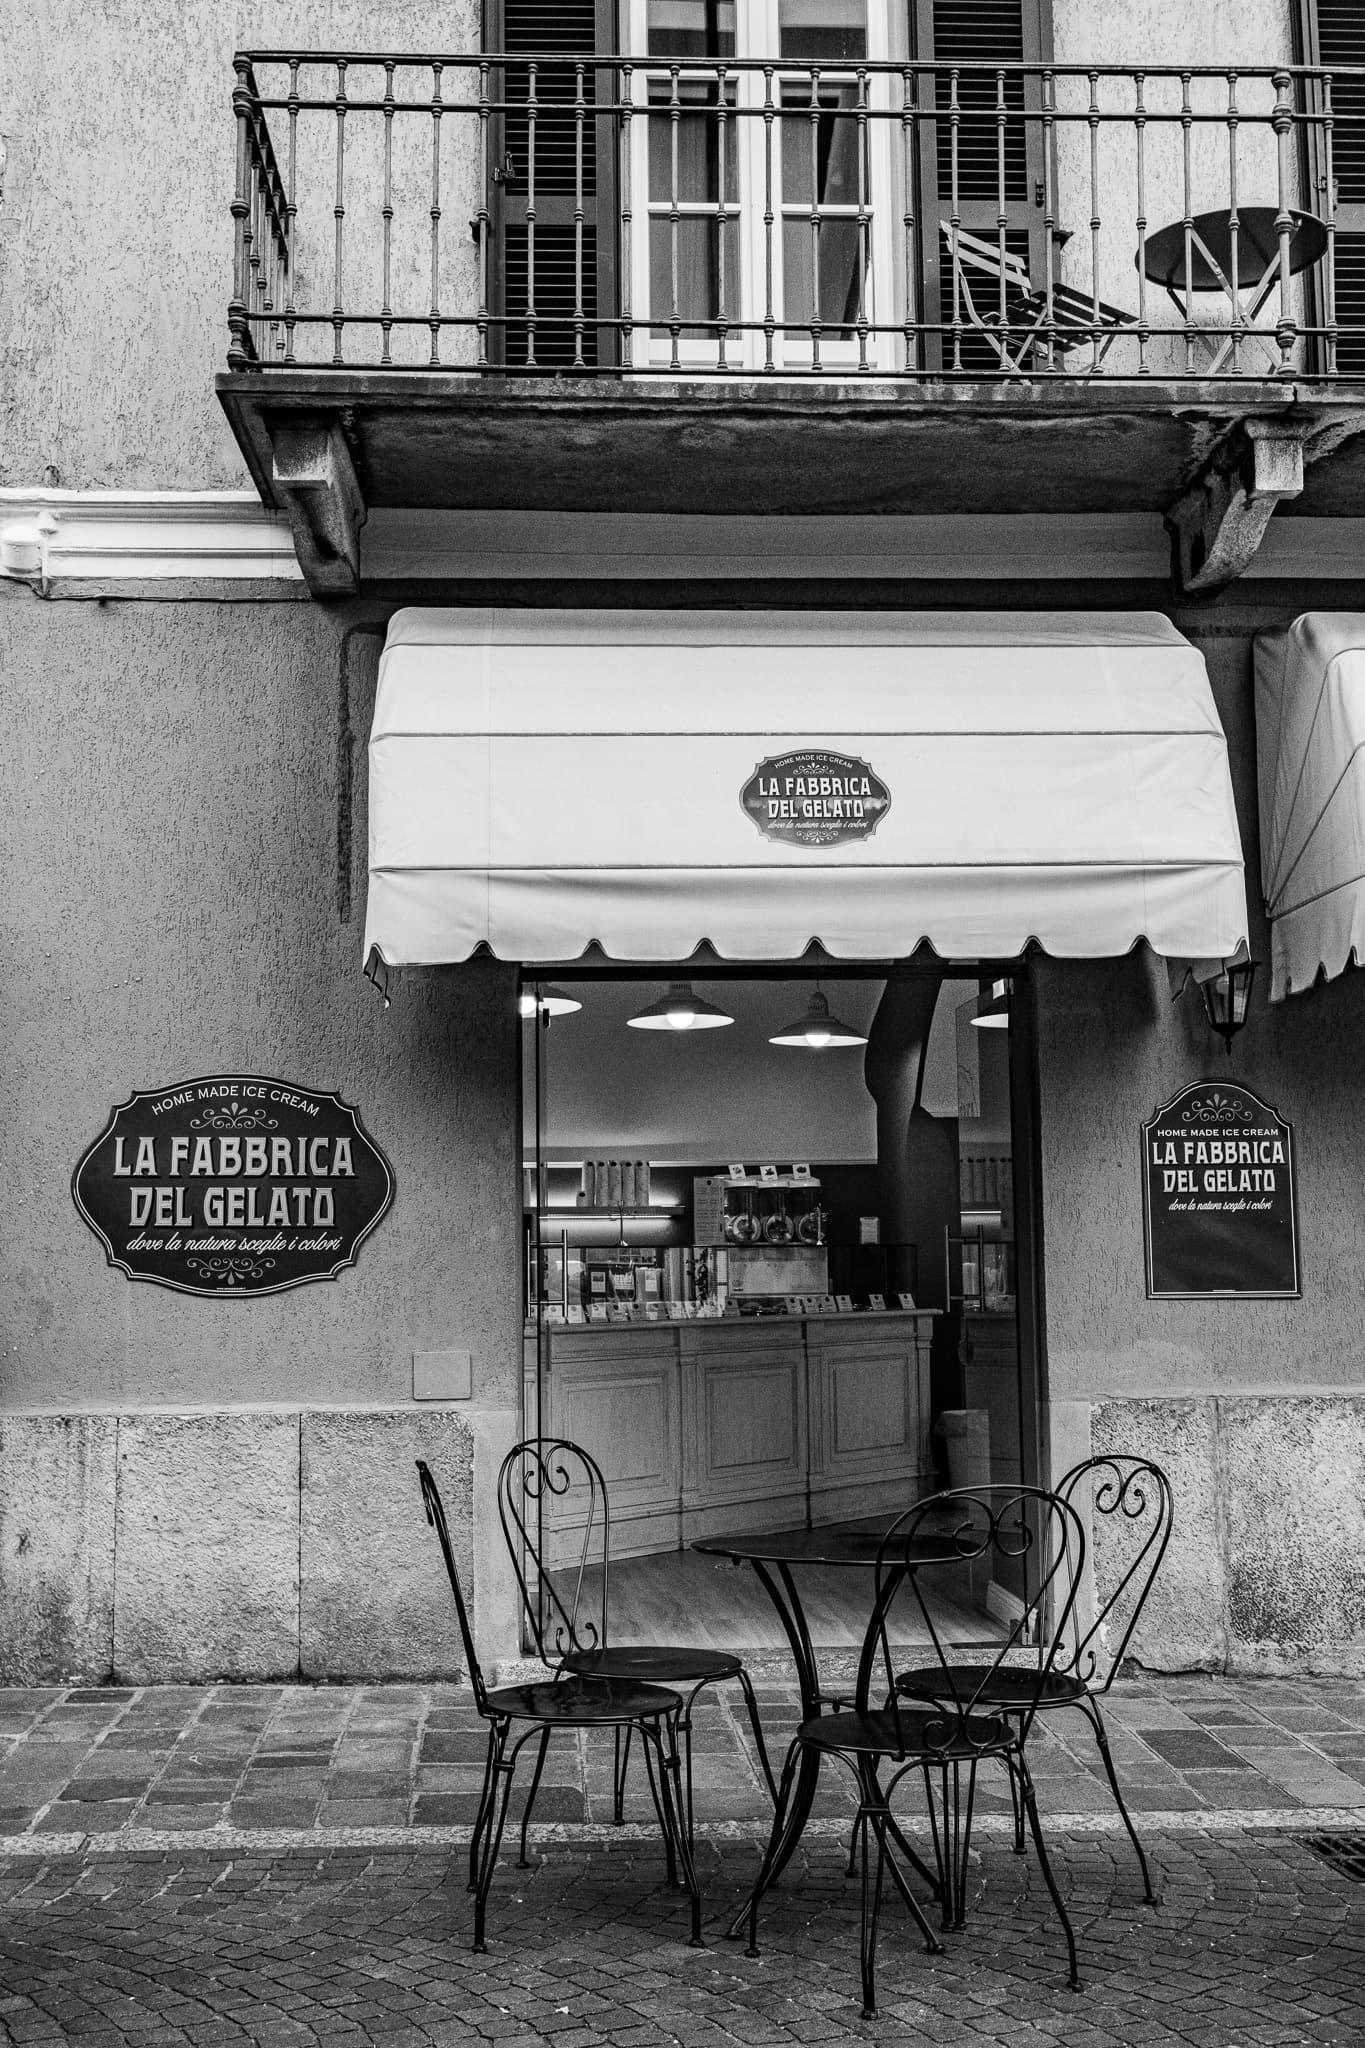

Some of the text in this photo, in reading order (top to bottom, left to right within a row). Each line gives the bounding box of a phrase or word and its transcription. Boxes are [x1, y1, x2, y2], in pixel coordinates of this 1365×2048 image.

[774, 758, 794, 768] HOME
[829, 757, 853, 768] CREAM
[759, 778, 871, 796] LA FABBRICA
[768, 800, 864, 817] DEL GELATO
[152, 1086, 319, 1117] HOME MADE ICE CREAM
[113, 1137, 356, 1176] LA FABBRICA
[1153, 1142, 1285, 1164] LA FABBRICA
[1163, 1169, 1275, 1192] DEL GELATO
[129, 1187, 336, 1226] DEL GELATO
[1169, 1198, 1273, 1212] dove la natura sceglie i colori
[126, 1232, 342, 1254] dove la natura sceglie i colori
